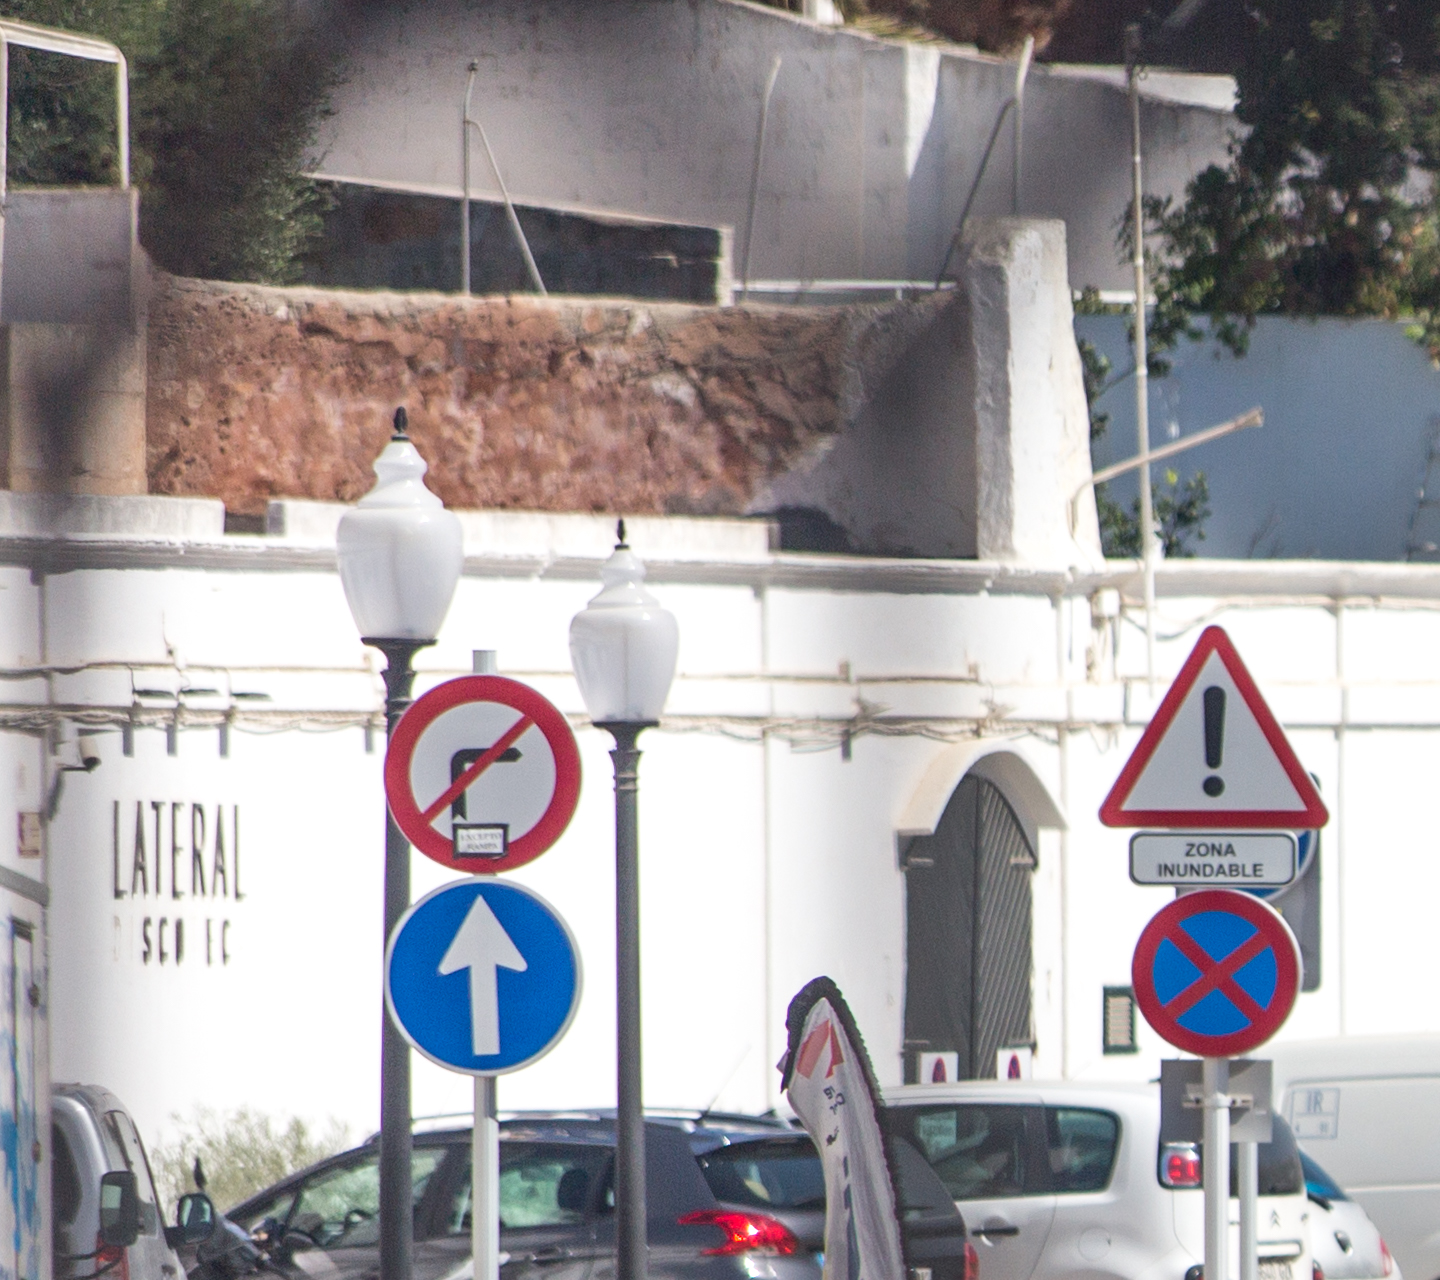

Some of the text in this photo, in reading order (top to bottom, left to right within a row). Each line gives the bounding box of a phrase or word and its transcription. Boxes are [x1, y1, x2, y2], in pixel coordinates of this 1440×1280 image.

[112, 799, 246, 901] LATERAL
[1185, 842, 1236, 857] ZONA
[1158, 862, 1264, 878] INUNDABLE
